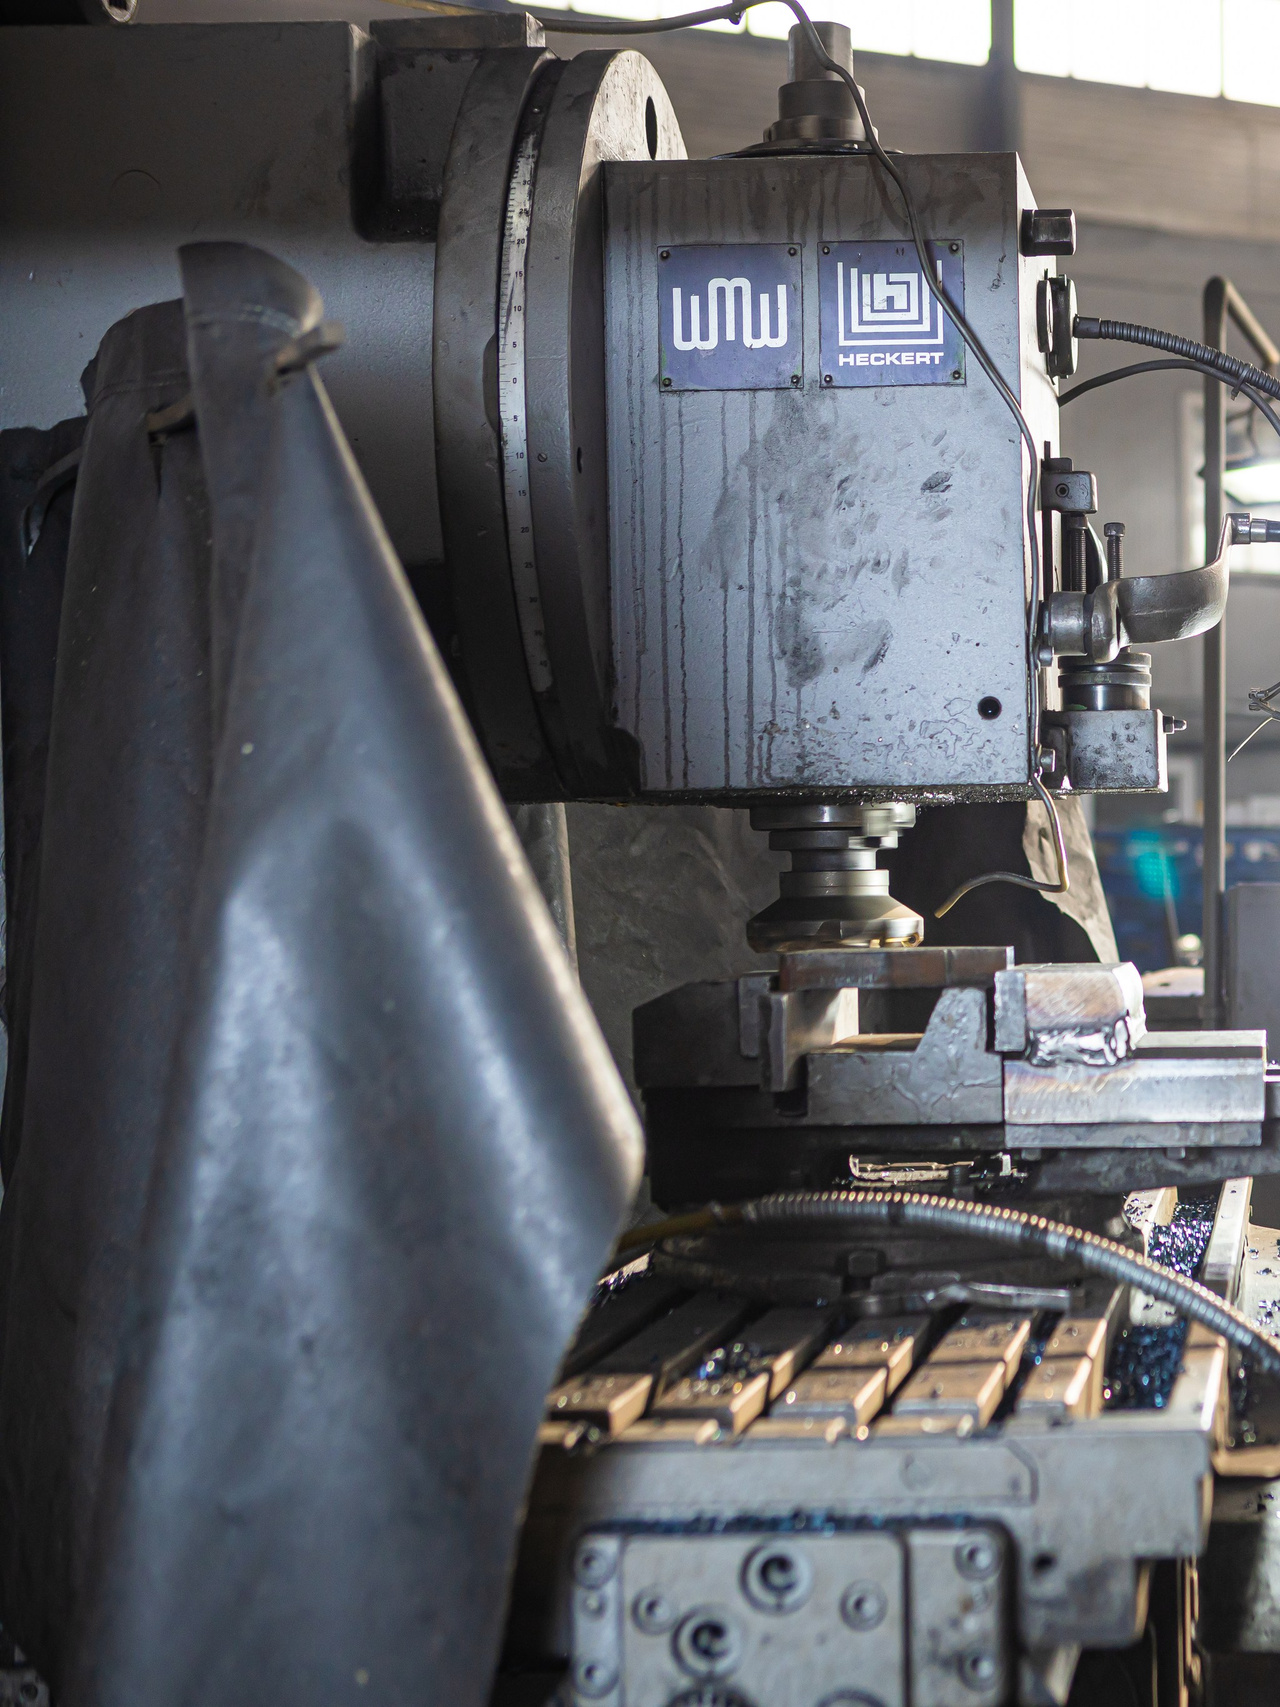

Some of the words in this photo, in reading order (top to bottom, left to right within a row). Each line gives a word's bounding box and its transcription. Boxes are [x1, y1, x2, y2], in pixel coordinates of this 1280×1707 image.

[515, 270, 523, 278] 15
[838, 351, 945, 367] HECKERT
[513, 414, 518, 422] 5
[518, 489, 527, 497] 15
[520, 526, 530, 534] 20
[524, 561, 533, 569] 25
